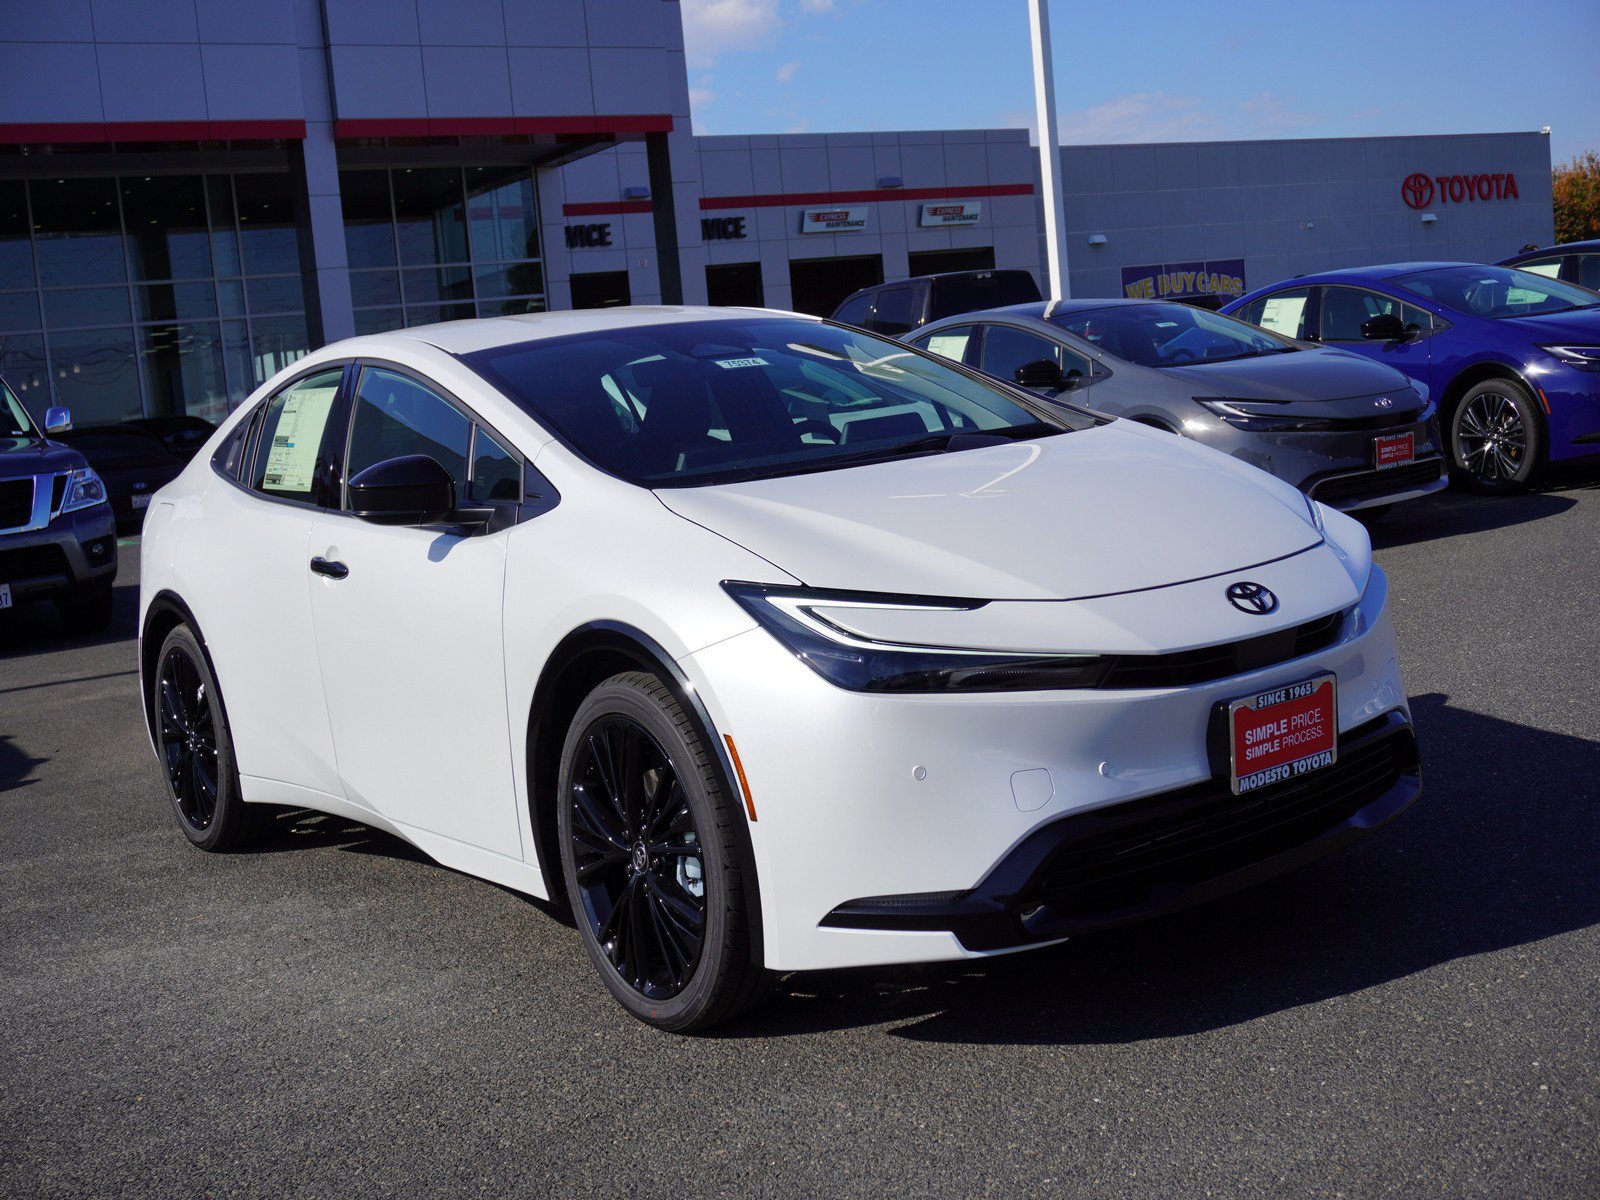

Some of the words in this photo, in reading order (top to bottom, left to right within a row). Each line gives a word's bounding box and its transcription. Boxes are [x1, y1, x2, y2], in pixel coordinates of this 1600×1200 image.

[1436, 174, 1519, 203] TOYOTA
[819, 213, 847, 221] EXPRESS
[826, 219, 865, 228] MAINTENANCE
[936, 207, 962, 215] EXPRESS
[942, 214, 978, 222] MAINTENANCE
[1125, 277, 1156, 299] WE
[1158, 272, 1196, 296] BUY
[1197, 272, 1243, 297] CARS
[1258, 694, 1286, 708] SINCE
[1289, 684, 1312, 699] 1965
[1245, 719, 1287, 745] SIMPLE
[1291, 708, 1324, 730] PRICE.
[1245, 739, 1280, 760] SIMPLE
[1283, 726, 1325, 748] PROCESS.
[1240, 766, 1290, 792] MODESTO
[1293, 752, 1332, 774] TOYOTA
